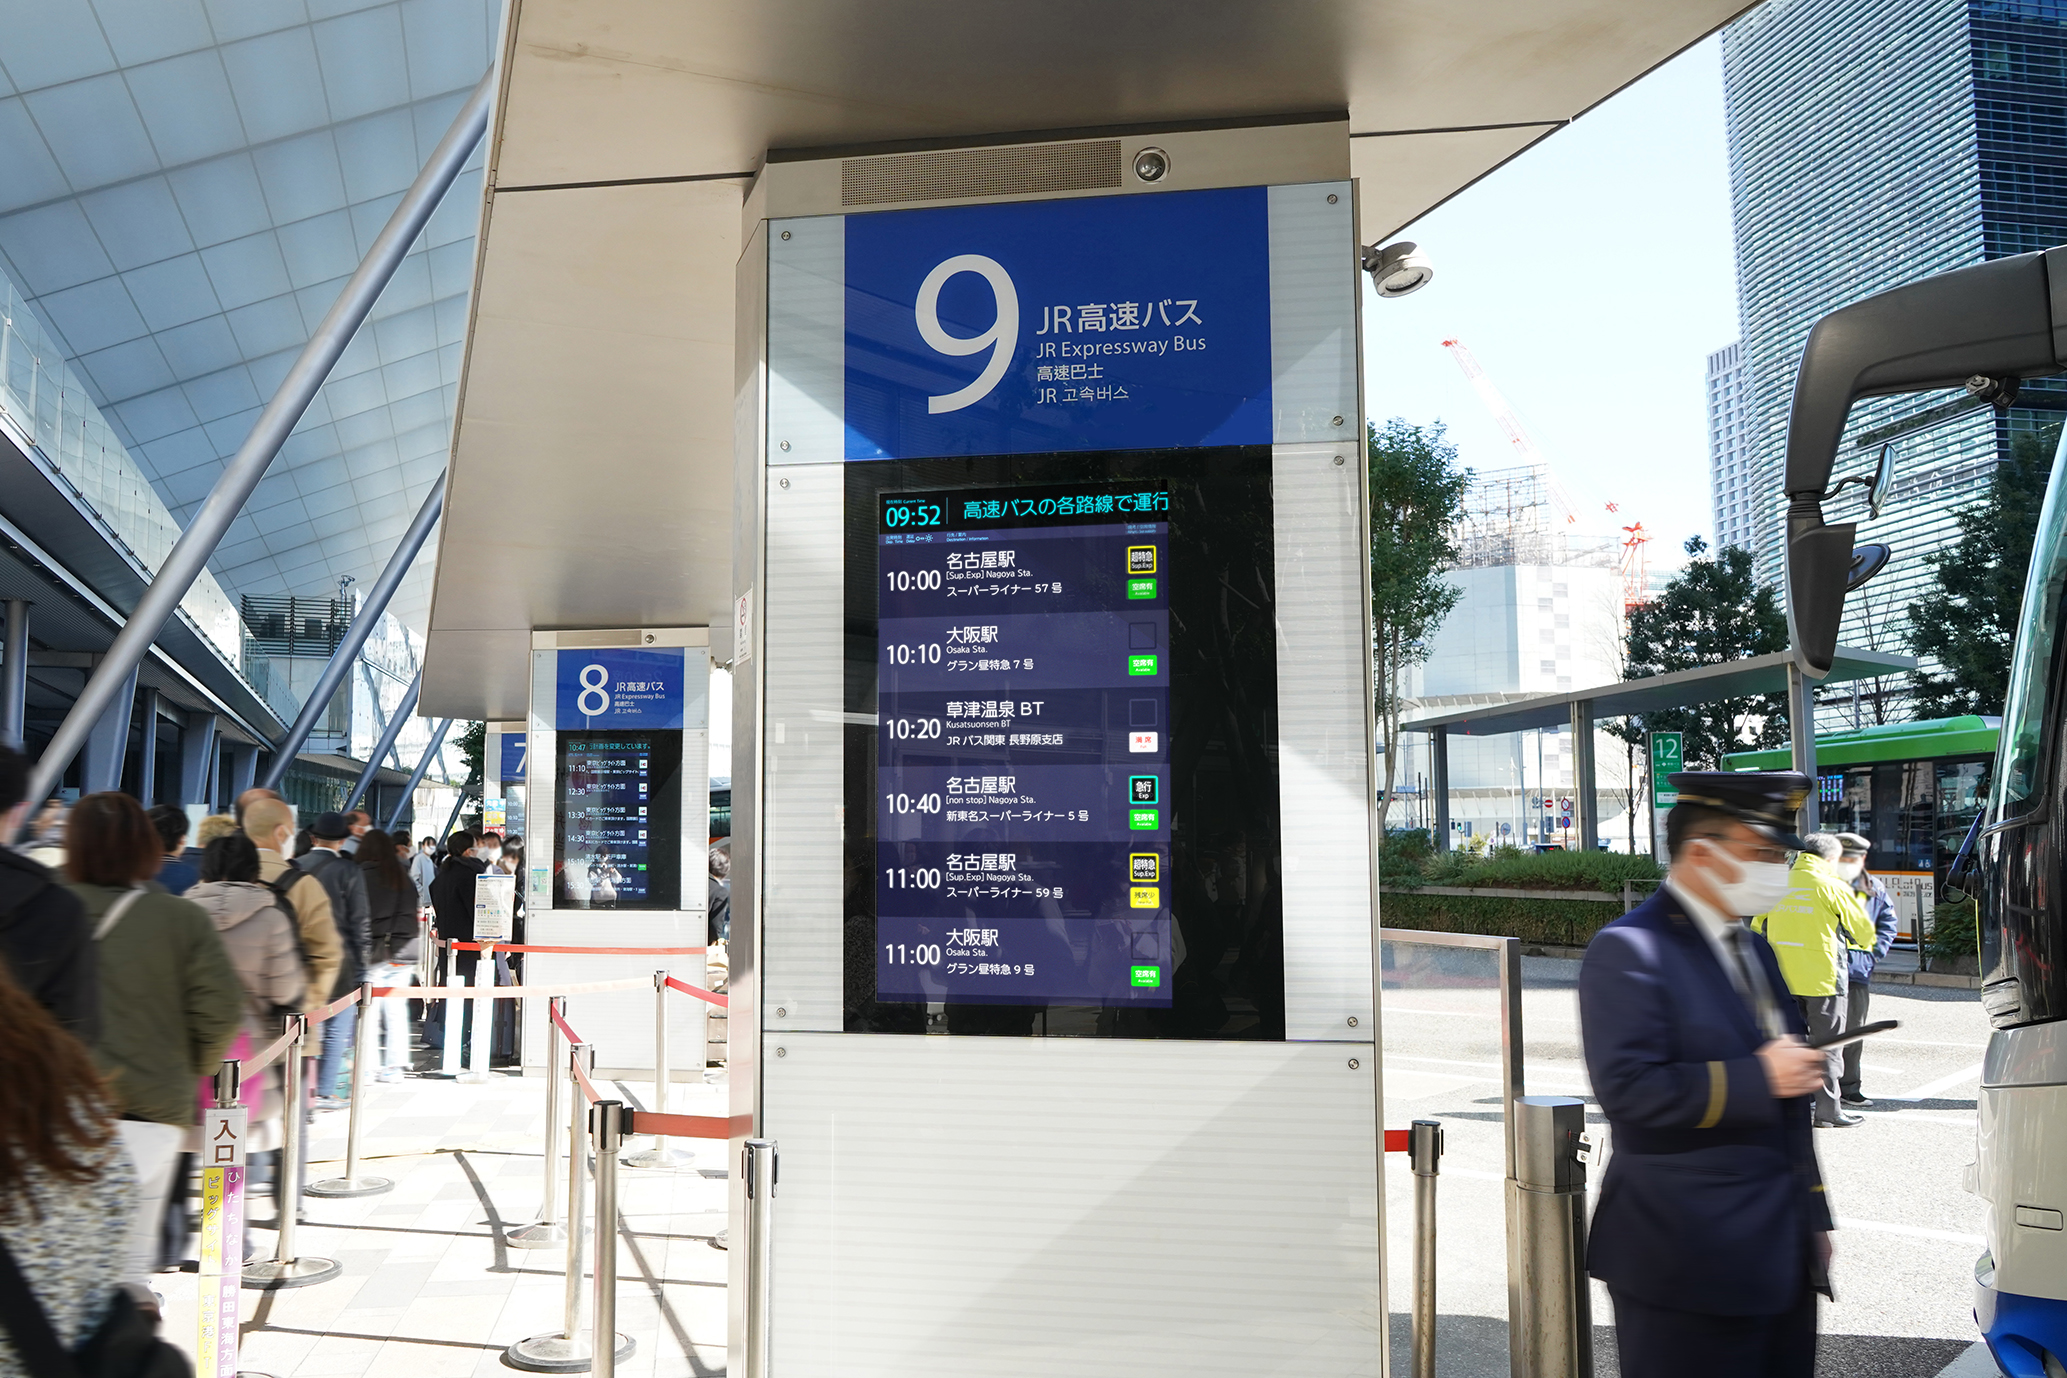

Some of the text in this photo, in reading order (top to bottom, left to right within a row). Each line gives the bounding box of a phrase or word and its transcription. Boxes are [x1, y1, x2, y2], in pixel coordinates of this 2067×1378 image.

[1036, 298, 1203, 336] JR高速バス
[915, 254, 1019, 415] 9
[1036, 335, 1206, 360] JR Expressway Bus
[1037, 363, 1104, 383] 高速巴士
[1037, 384, 1129, 404] JR 고속버스
[964, 491, 1168, 519] 高速バスの各路線で運行
[886, 505, 941, 527] 09:52
[946, 550, 1016, 570] 名古屋駅
[1131, 551, 1153, 562] 超特急
[887, 570, 941, 591] 10:00
[946, 569, 1033, 580] [Sup.Exp] Nagoya Sta.
[947, 582, 1062, 597] スーパーライナー 57 号
[946, 625, 998, 644] 大阪駅
[887, 643, 941, 664] 10:10
[946, 645, 988, 654] Osaka Sta.
[946, 658, 1034, 672] グラン昼特急 7 号
[577, 664, 610, 716] 8
[614, 681, 665, 693] JR高速バス
[622, 693, 654, 701] Expressway
[946, 700, 1044, 719] 草津温泉 BT
[887, 718, 941, 740] 10:20
[946, 720, 1011, 729] Kusatsuonsen BT
[946, 734, 1063, 746] JR バス関東 長野原支店
[1655, 738, 1678, 759] 12
[568, 764, 586, 772] 11:10
[568, 788, 586, 796] 12:30
[946, 776, 1016, 794] 名古屋駅
[1135, 781, 1152, 793] 急行
[886, 793, 941, 814] 10:40
[945, 795, 1037, 805] [non stop] Nagoya Sta.
[567, 811, 585, 819] 13:30
[946, 810, 1089, 822] 新東名スーパーライナー 5 号
[567, 834, 585, 842] 14:30
[567, 858, 585, 866] 15:10
[946, 853, 1016, 871] 名古屋駅
[1133, 858, 1155, 870] 超特急
[886, 868, 941, 889] 11:00
[945, 872, 1034, 883] [Sup.Exp] Nagoya Sta.
[947, 886, 1064, 899] スーパーライナー 59 号
[946, 928, 998, 947] 大阪駅
[886, 944, 941, 965] 11:00
[946, 948, 989, 957] Osaka Sta.
[946, 963, 1035, 976] グラン昼特急 9 号
[213, 1119, 237, 1164] 入口
[206, 1175, 221, 1266] ビッグサイト
[225, 1171, 241, 1267] ひたちなか
[220, 1284, 237, 1378] 勝田東海方面
